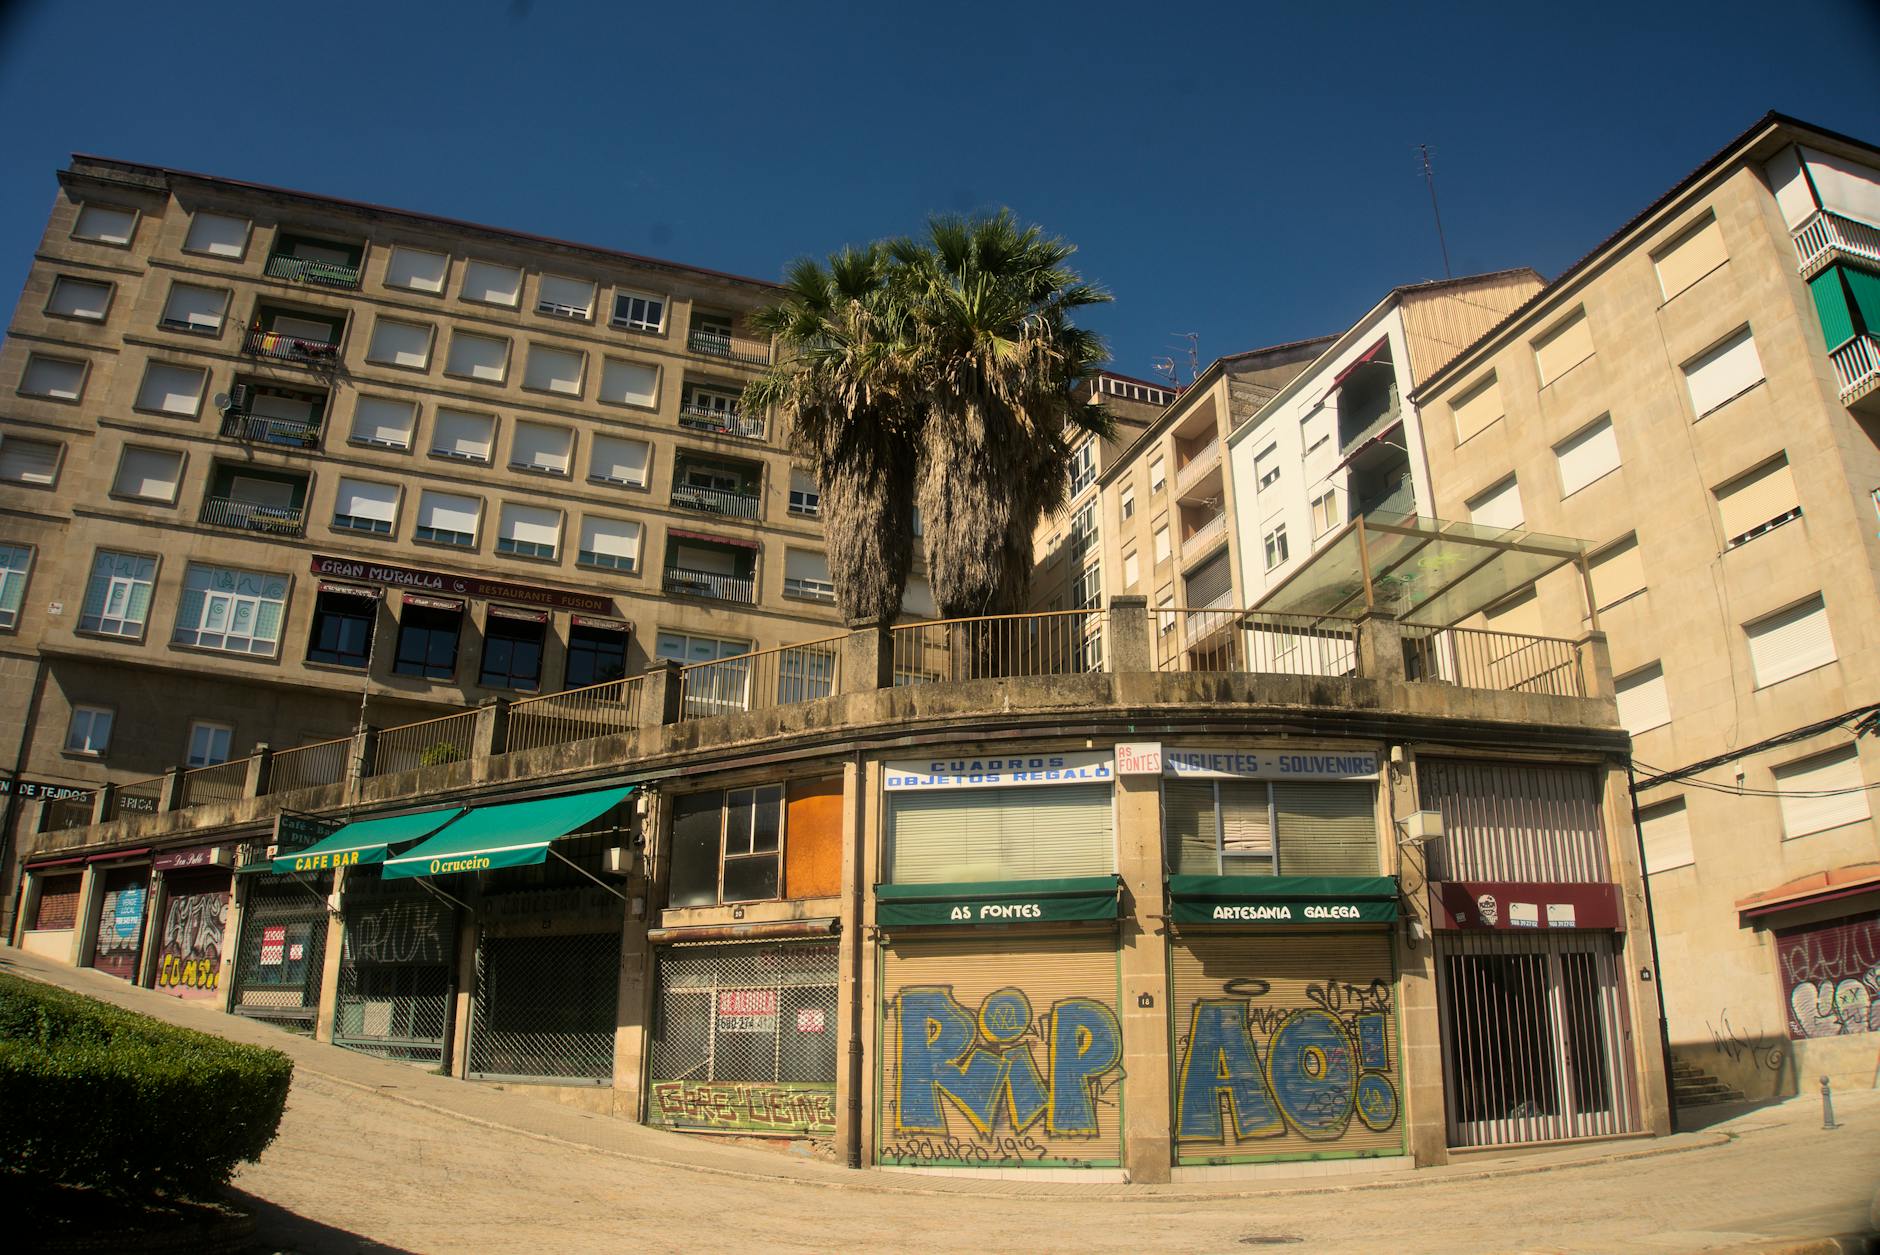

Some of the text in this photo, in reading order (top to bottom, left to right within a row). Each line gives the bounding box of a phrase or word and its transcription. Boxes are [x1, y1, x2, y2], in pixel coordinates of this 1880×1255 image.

[321, 560, 363, 576] GRAN
[369, 567, 442, 588] MURALLA
[479, 585, 552, 602] RESTAURANTE
[562, 597, 602, 609] FUSION
[1118, 747, 1132, 757] AS
[931, 757, 1064, 772] CUADROS
[1119, 753, 1159, 772] FONTES
[1164, 753, 1258, 772] JUGUETES
[1280, 756, 1376, 774] SOUVENIRS
[888, 767, 1110, 787] OBJETOS REGALO
[19, 784, 35, 796] DE
[40, 786, 87, 802] TEJIDOS
[295, 851, 359, 871] CAFE BAR
[430, 856, 490, 874] O cruceiro
[950, 904, 1041, 920] AS FONTES
[1213, 905, 1360, 920] ARTESANIA GALEGA
